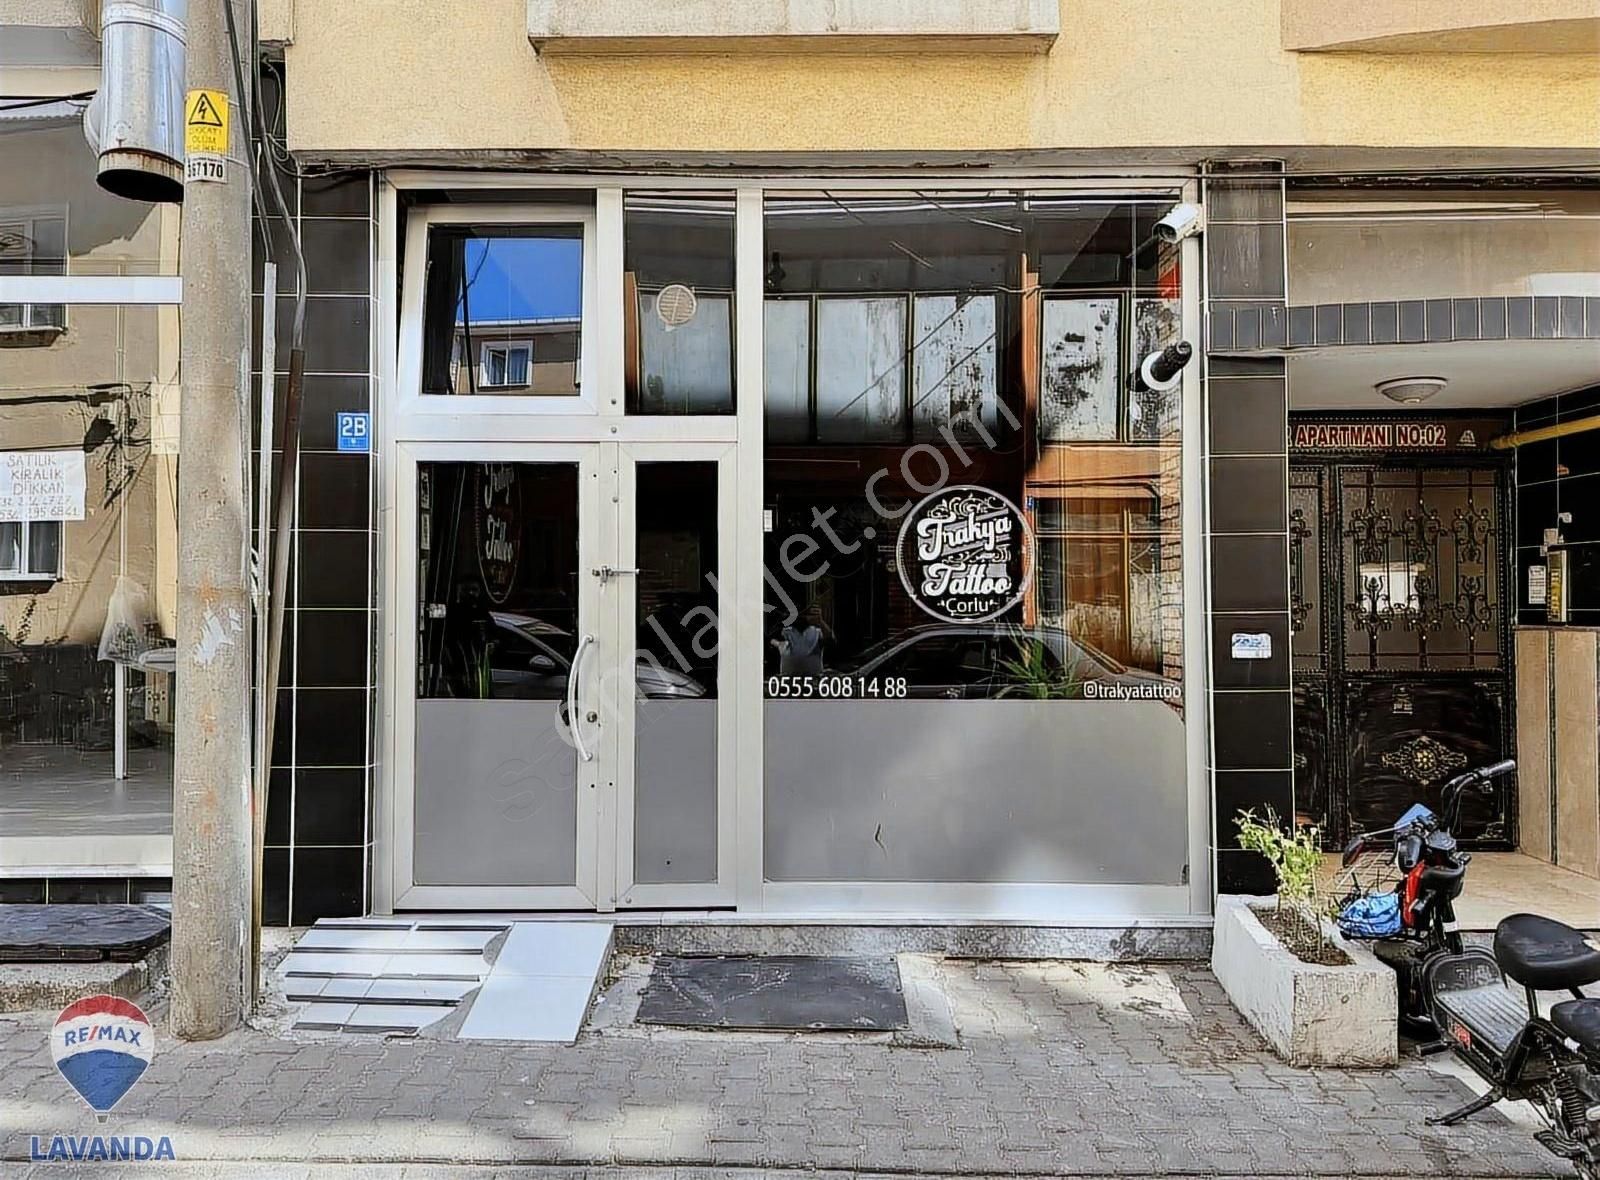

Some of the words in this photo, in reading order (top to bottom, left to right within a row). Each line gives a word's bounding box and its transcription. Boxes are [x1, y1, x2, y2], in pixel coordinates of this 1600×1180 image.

[342, 416, 366, 437] 2B
[1295, 424, 1393, 448] APARTMANI
[1396, 424, 1446, 447] NO:02
[917, 511, 1012, 561] Trakya
[924, 562, 1012, 596] Tattoo
[768, 676, 813, 697] 0555
[818, 676, 853, 697] 608
[858, 677, 880, 698] 14
[884, 677, 907, 697] 88
